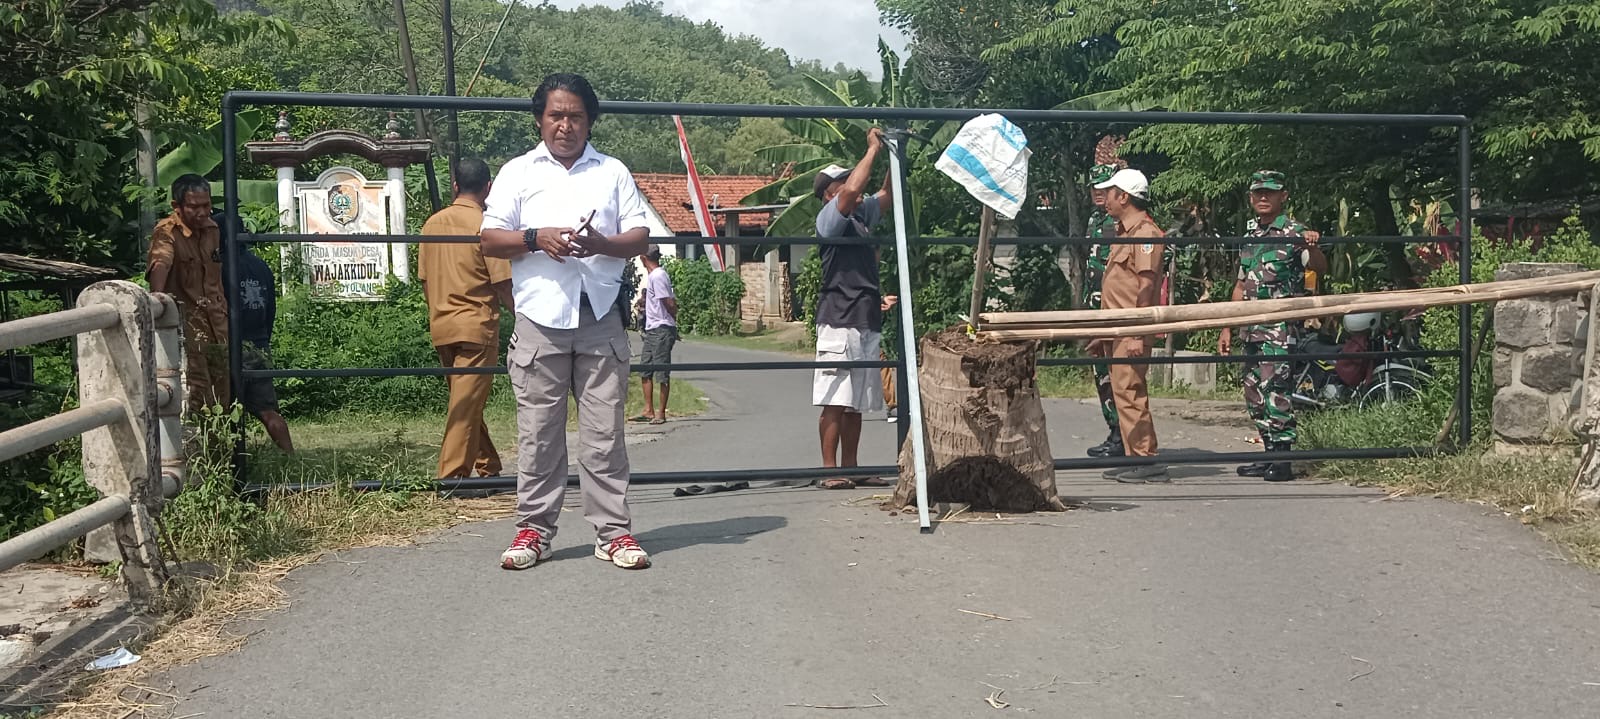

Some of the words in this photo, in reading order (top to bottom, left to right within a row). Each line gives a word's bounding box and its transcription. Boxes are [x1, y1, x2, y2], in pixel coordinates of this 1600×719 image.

[333, 246, 360, 258] MASUK
[361, 246, 380, 257] DESA
[314, 263, 380, 281] WAJAKKIDUL
